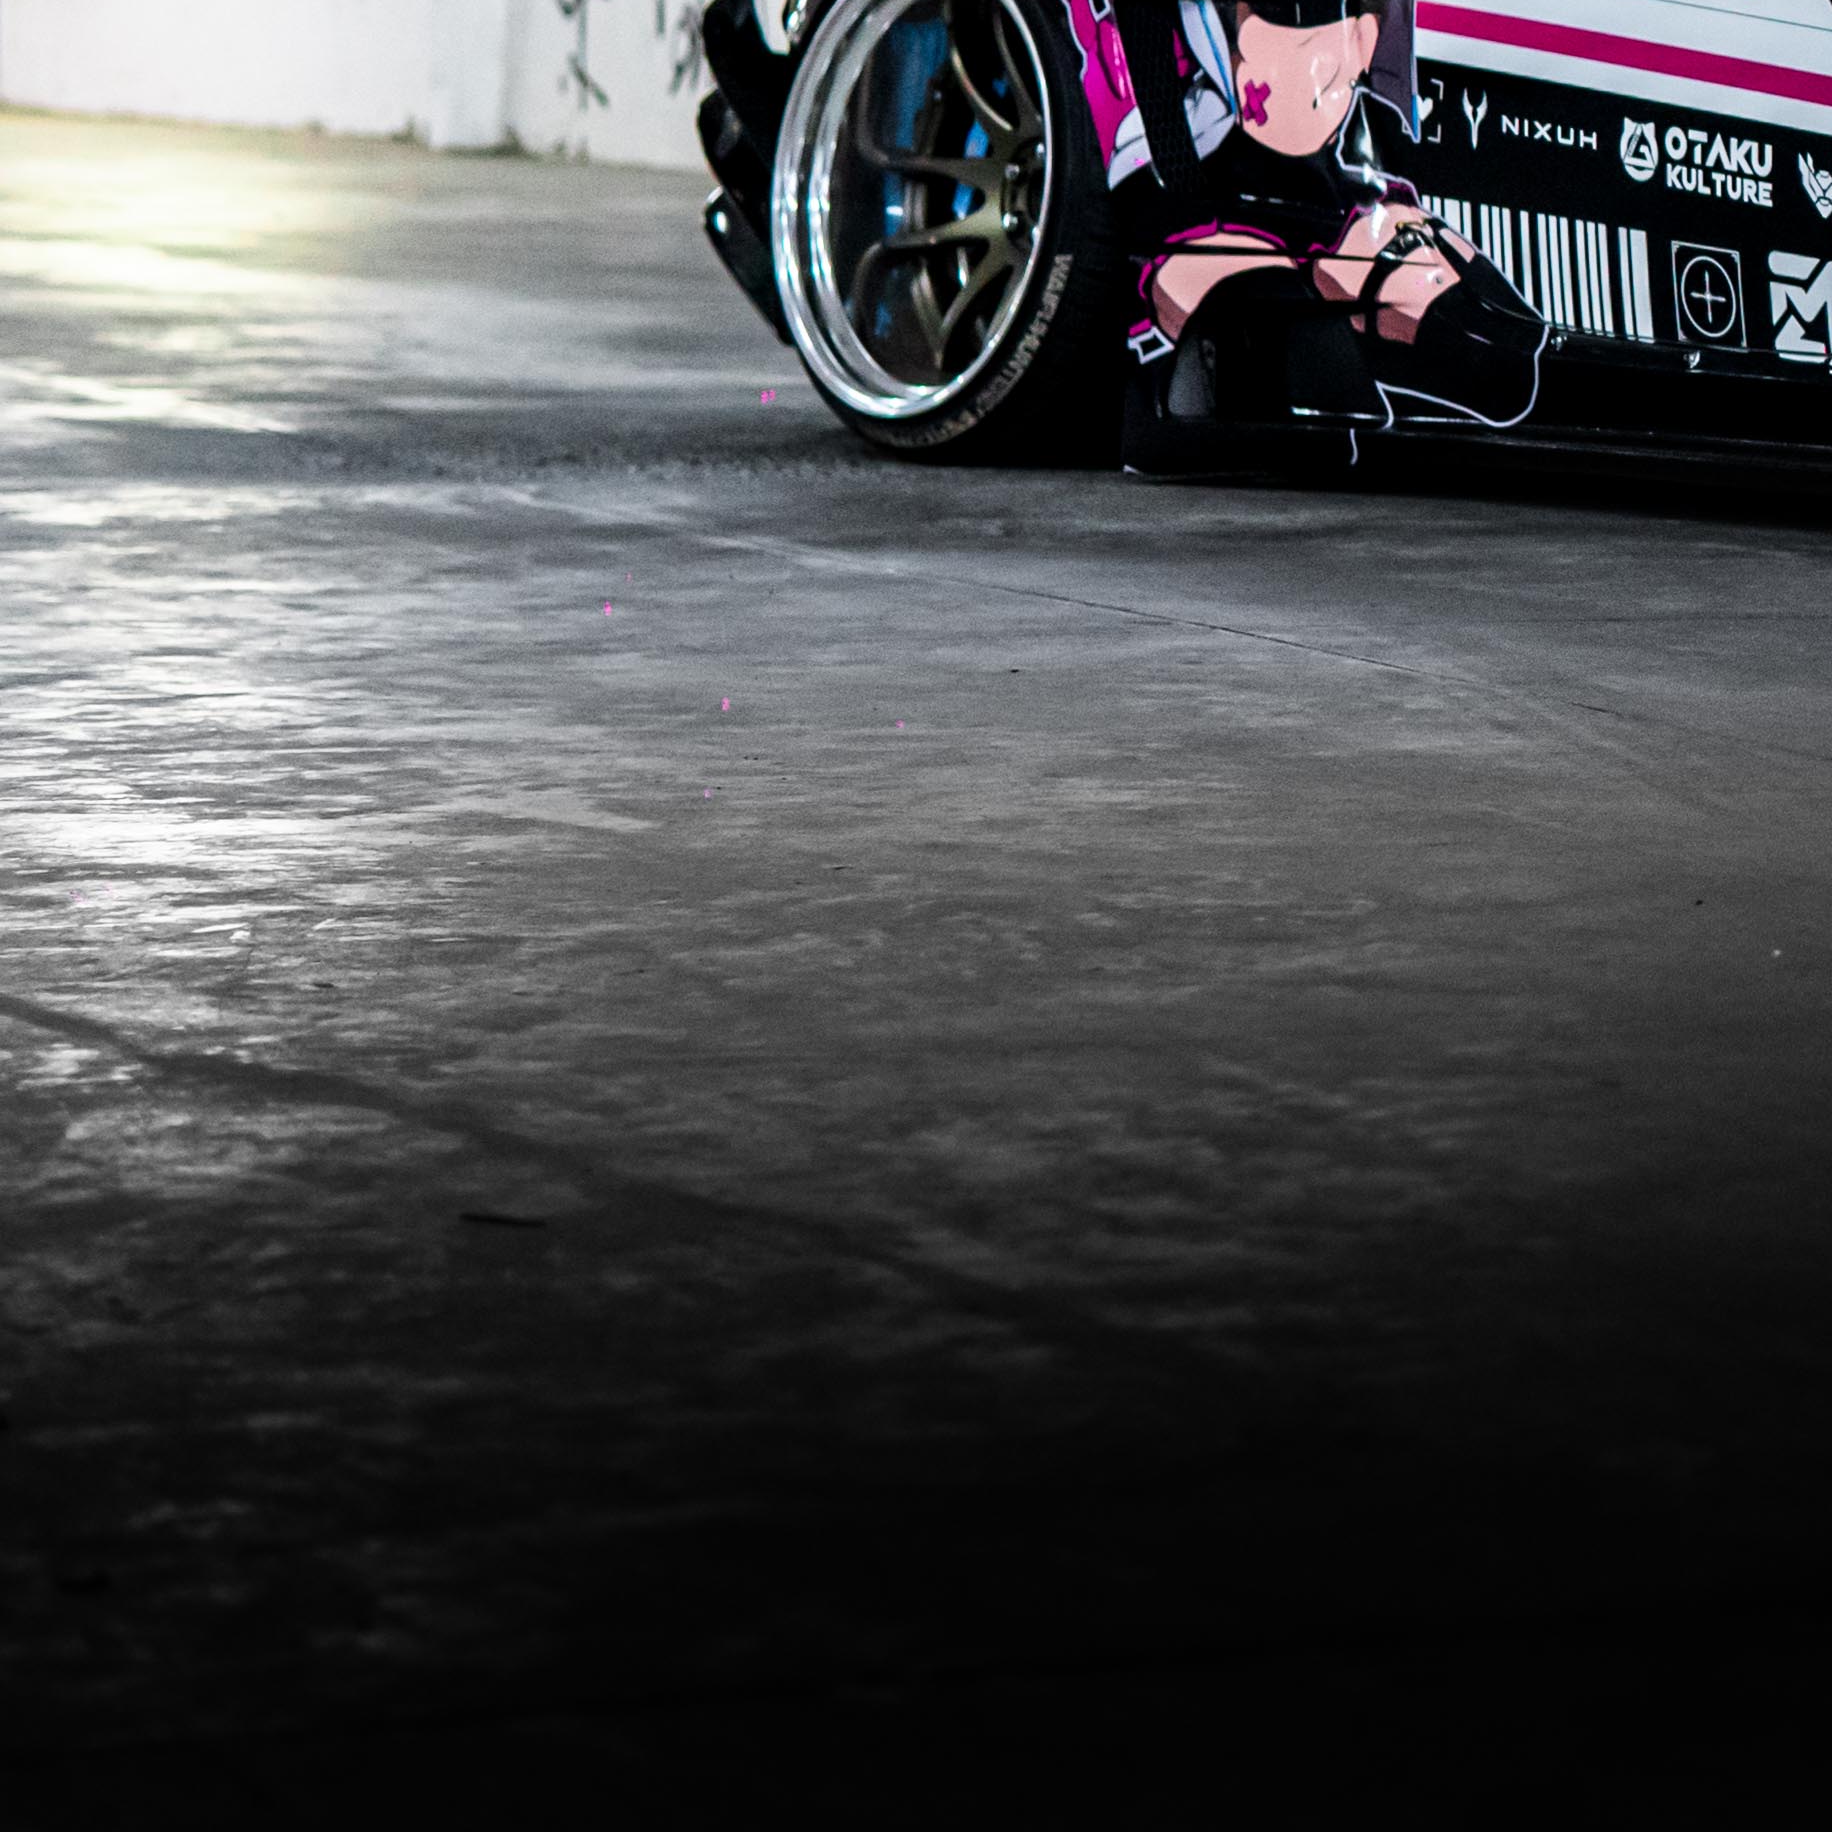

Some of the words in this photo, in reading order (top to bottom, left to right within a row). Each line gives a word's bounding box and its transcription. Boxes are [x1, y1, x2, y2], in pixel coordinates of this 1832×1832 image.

[1501, 114, 1597, 151] NIXUH
[1665, 126, 1774, 176] OTAKU
[1666, 162, 1774, 207] KULTURE
